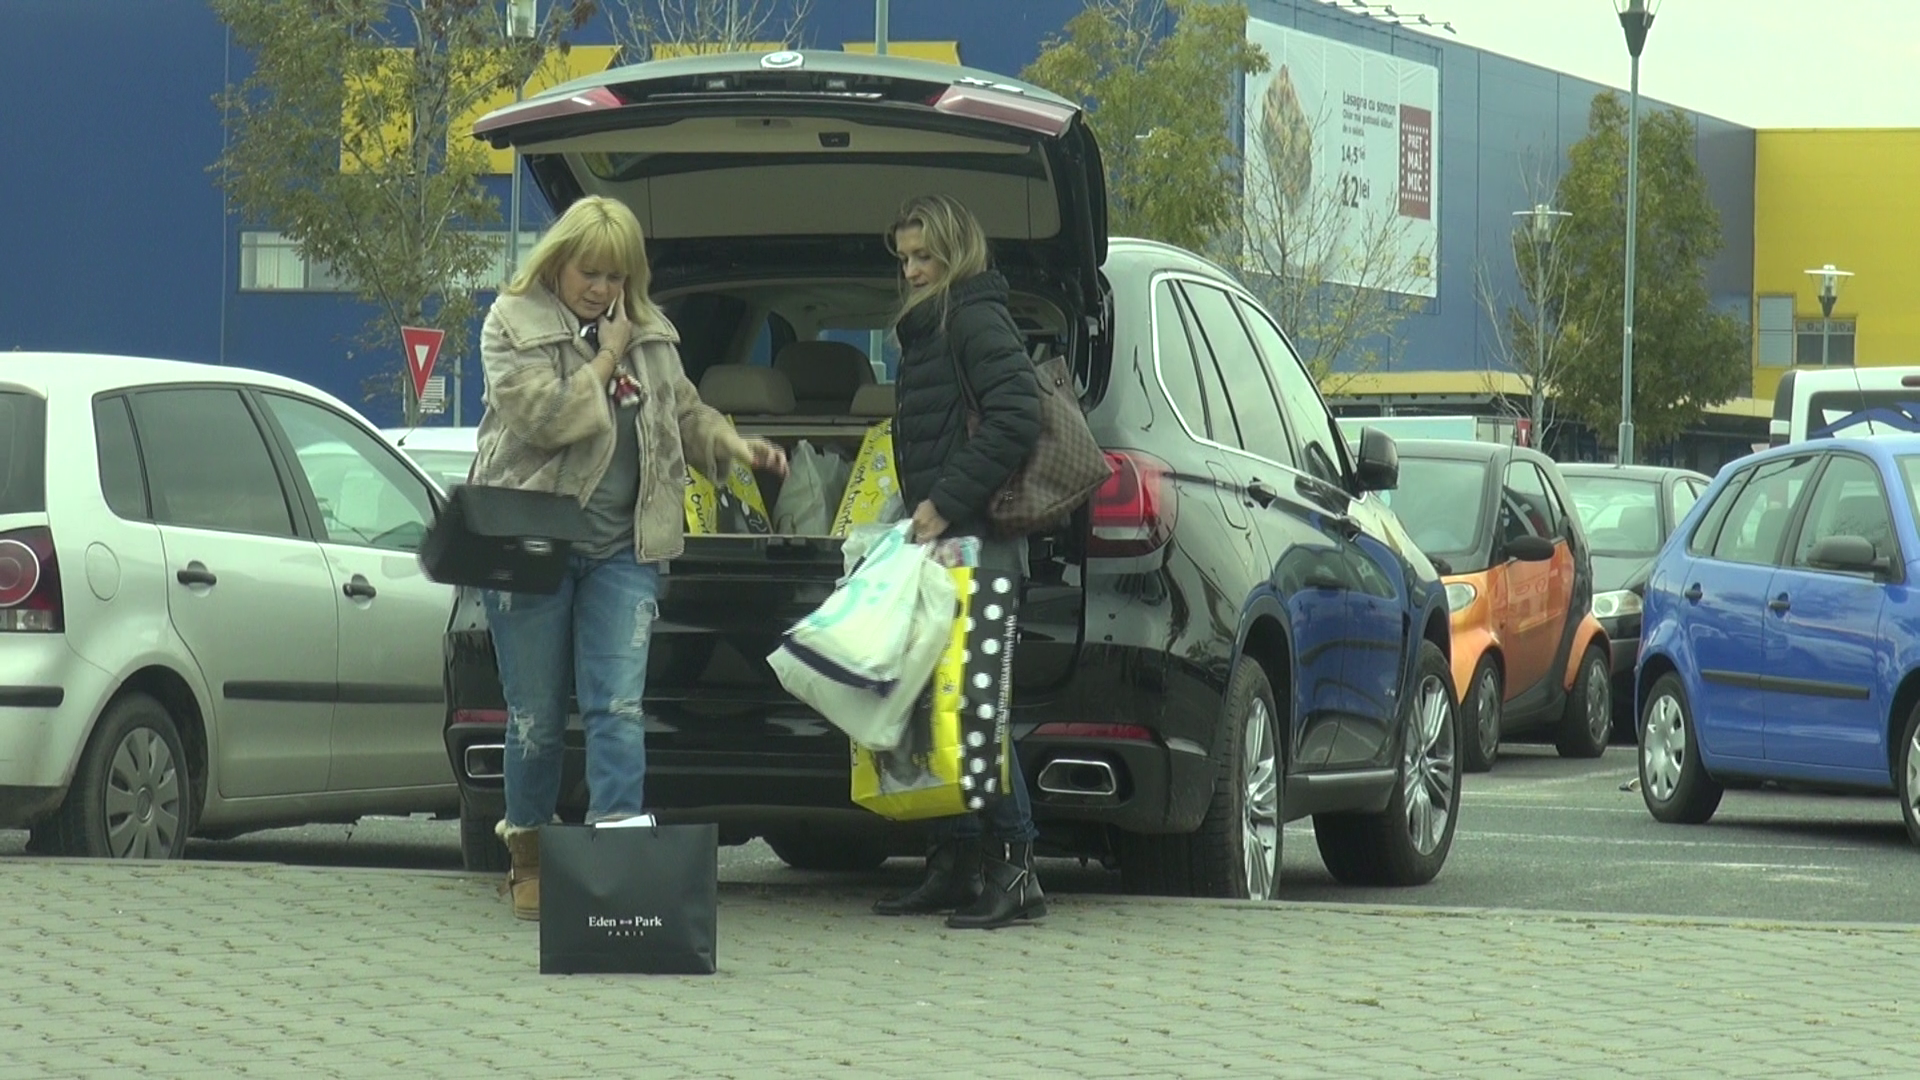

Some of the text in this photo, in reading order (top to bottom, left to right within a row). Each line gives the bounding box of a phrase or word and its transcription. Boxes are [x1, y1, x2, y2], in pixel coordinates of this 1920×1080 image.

[1407, 151, 1423, 171] MAI
[1342, 174, 1370, 208] 12 lei
[1407, 172, 1423, 193] MIC
[588, 915, 663, 928] Eden Park
